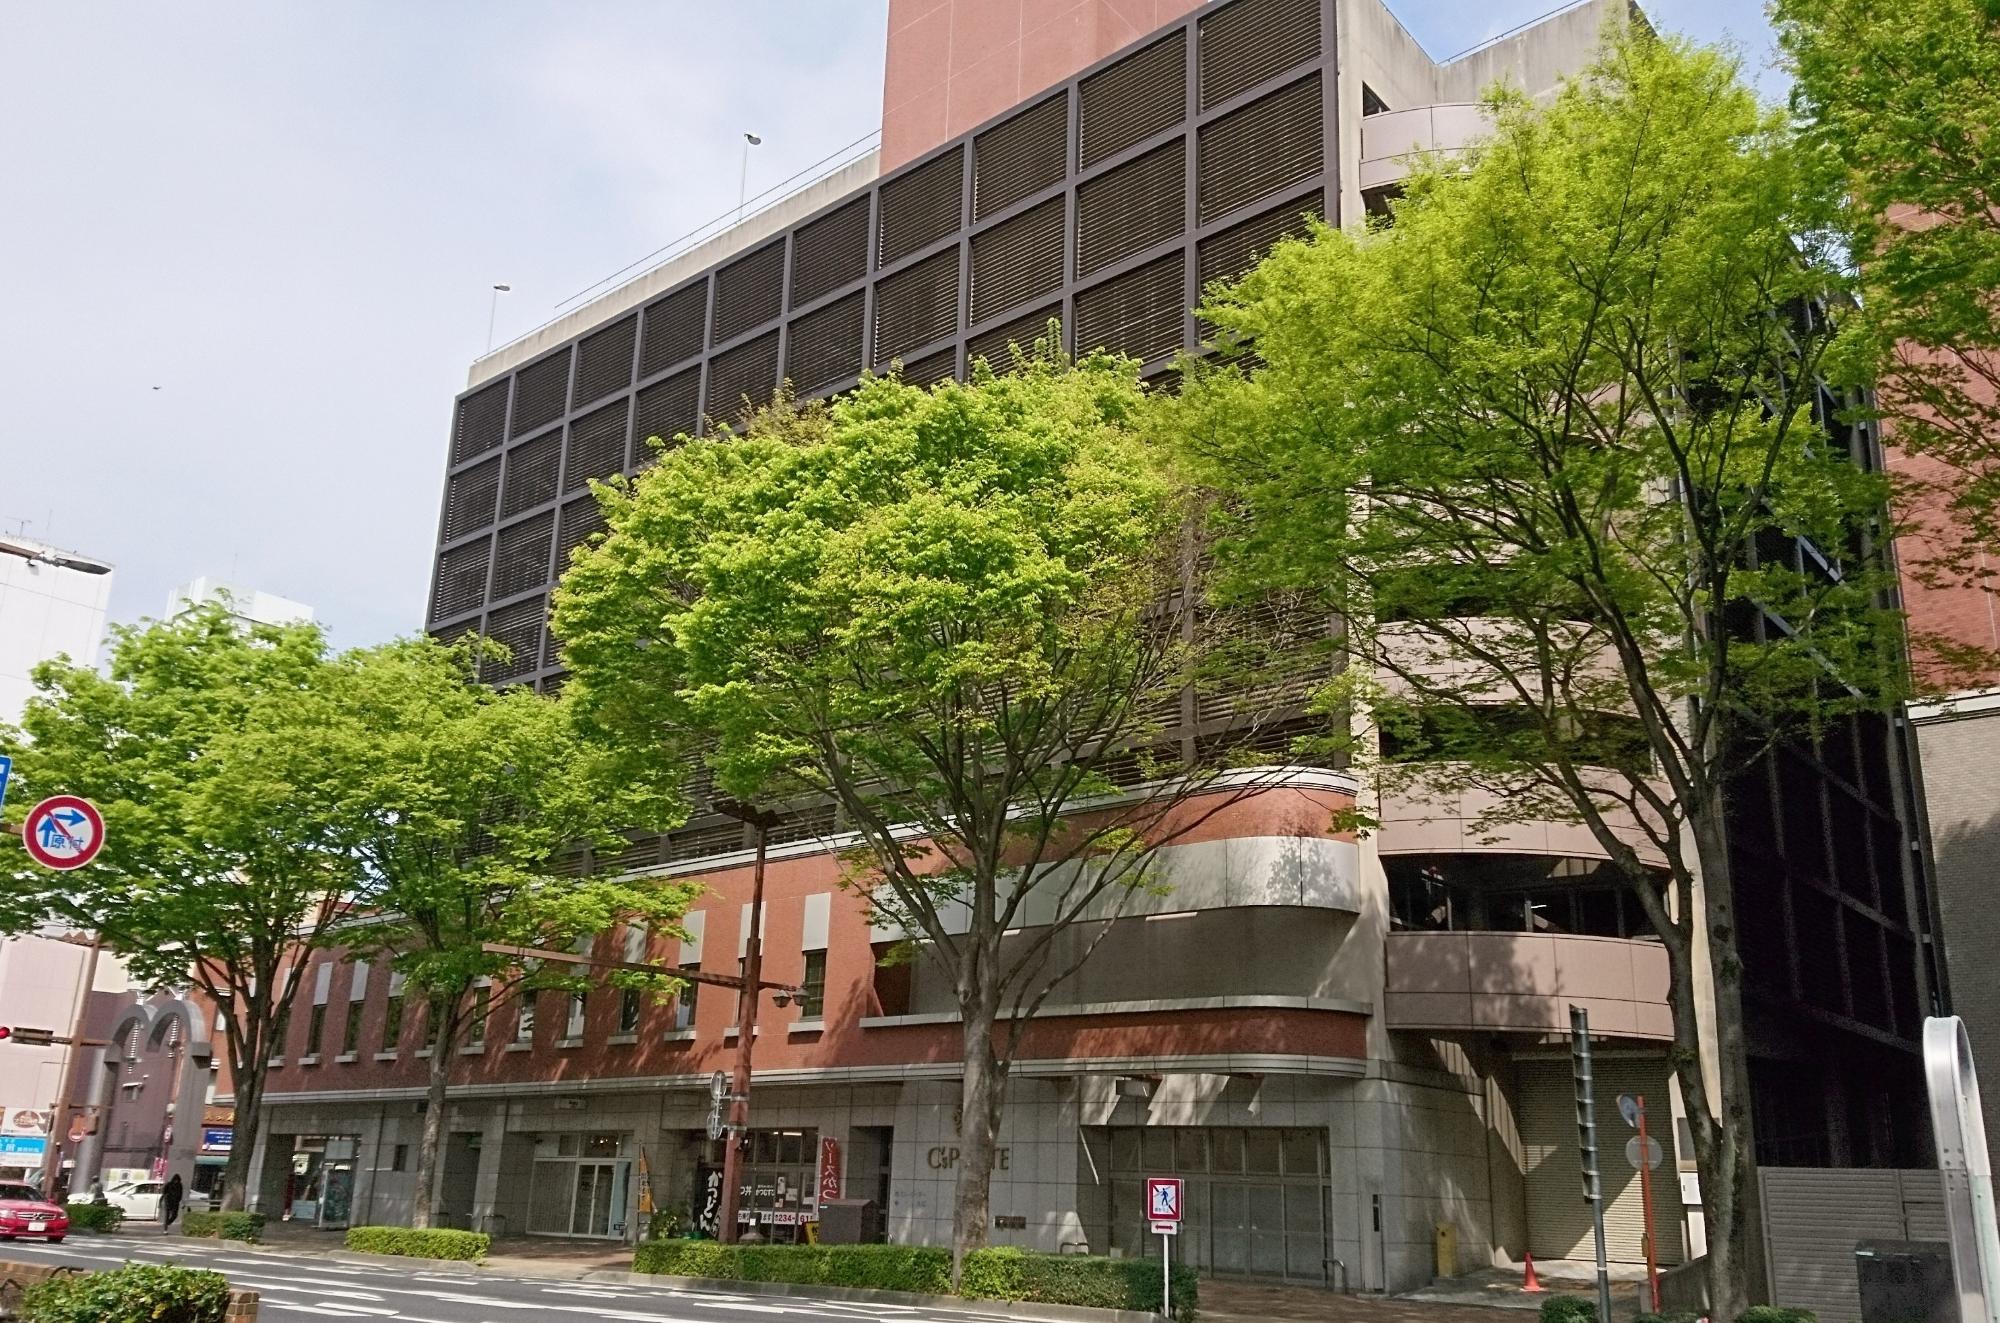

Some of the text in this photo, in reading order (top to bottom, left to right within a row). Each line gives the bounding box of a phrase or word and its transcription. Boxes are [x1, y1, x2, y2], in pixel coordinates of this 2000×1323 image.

[51, 834, 84, 850] 原付
[700, 1171, 723, 1231] かつどん
